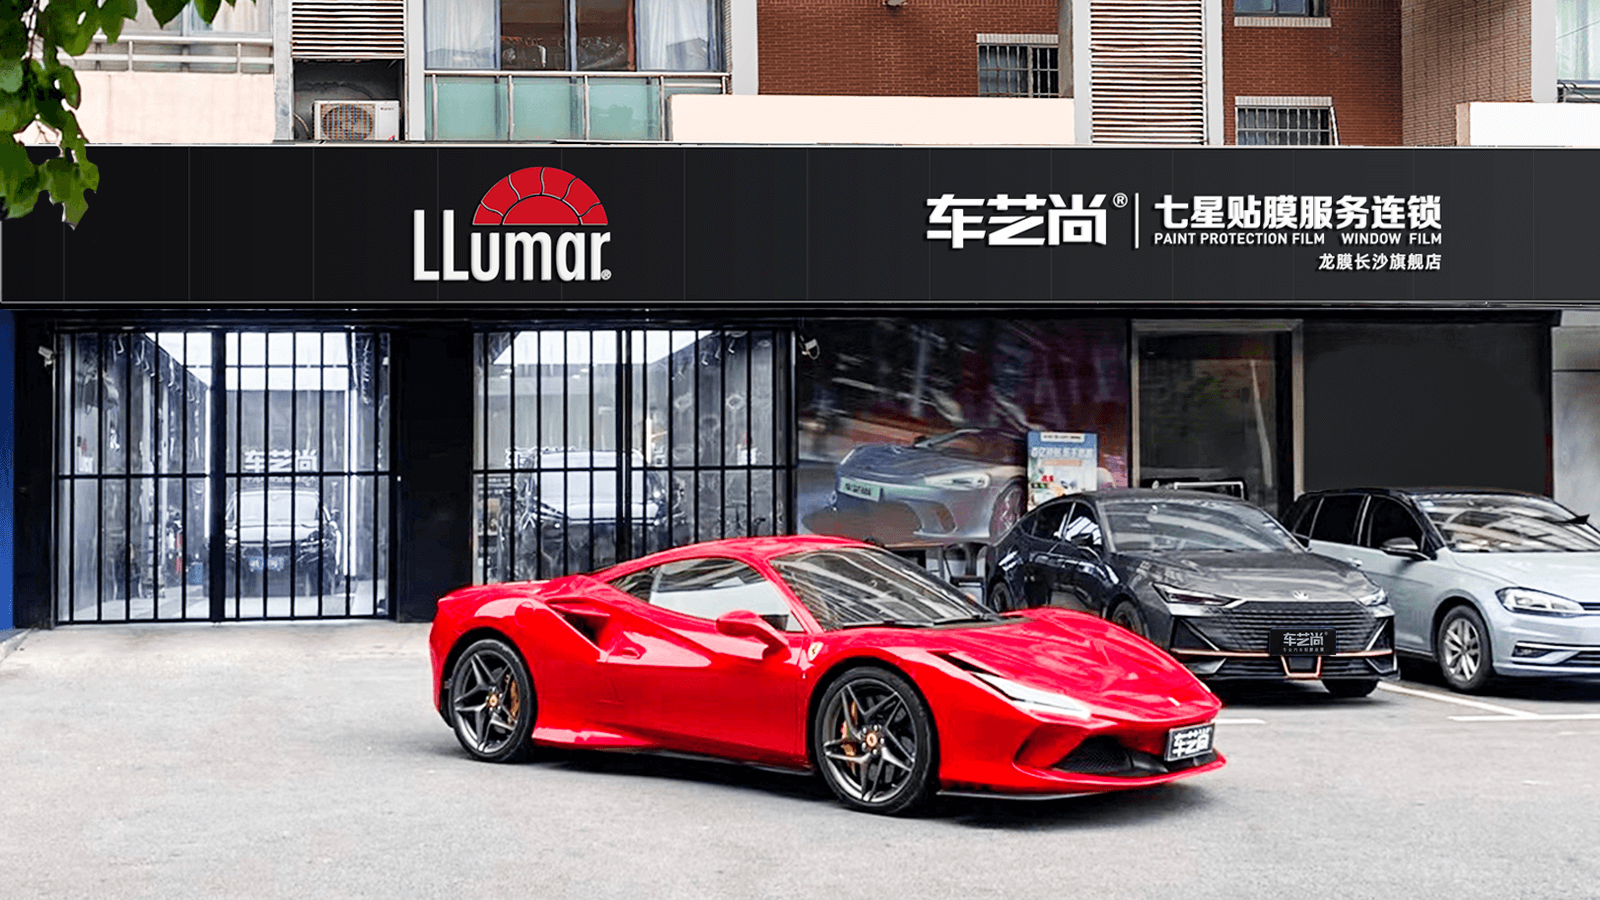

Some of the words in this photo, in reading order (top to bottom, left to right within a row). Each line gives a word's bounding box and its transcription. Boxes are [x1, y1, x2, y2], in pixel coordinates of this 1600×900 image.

[926, 194, 1107, 249] 车艺尚
[1154, 195, 1442, 229] 七星贴膜服务连锁
[1154, 233, 1196, 245] PAINT
[1200, 233, 1287, 245] PROTECTION
[1292, 233, 1325, 245] FILM
[1341, 233, 1401, 245] WINDOW
[1409, 233, 1442, 245] FILM
[1318, 253, 1442, 270] 龙膜长沙旗舰店
[1283, 632, 1324, 646] 车艺尚
[1172, 727, 1211, 757] 车艺尚
